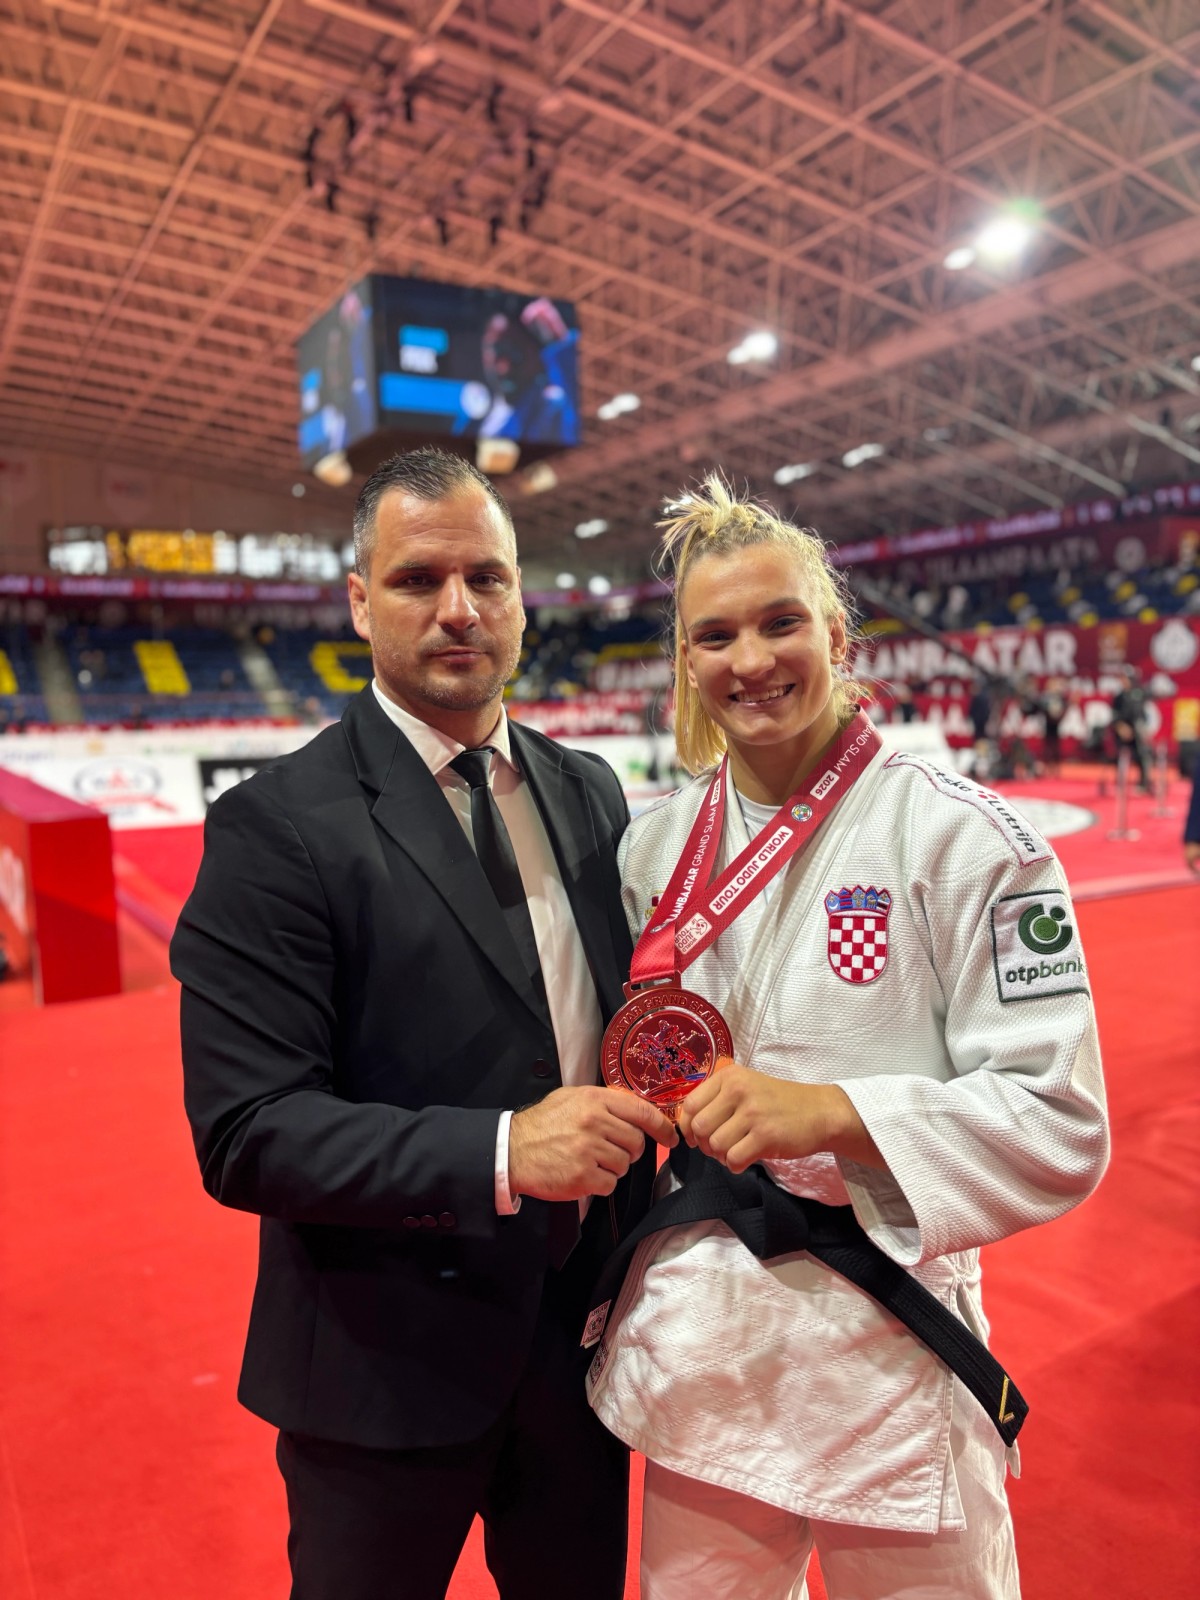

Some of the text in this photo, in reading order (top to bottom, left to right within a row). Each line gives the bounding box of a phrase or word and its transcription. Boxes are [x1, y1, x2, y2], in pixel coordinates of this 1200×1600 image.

[815, 722, 875, 796] RAND SLAM 2026
[987, 800, 1036, 853] Lutrija
[663, 867, 699, 924] LAANBAATAR
[691, 834, 710, 866] GRAND
[703, 806, 717, 834] SLAM
[712, 830, 790, 911] WORLD JUDO TOUR
[675, 927, 690, 944] TOUR
[677, 931, 694, 949] JUDO
[682, 937, 698, 953] WORLD
[1005, 956, 1084, 985] otpbank
[644, 994, 688, 1008] GRAND
[690, 1000, 719, 1029] SLAM
[713, 1029, 728, 1057] 202
